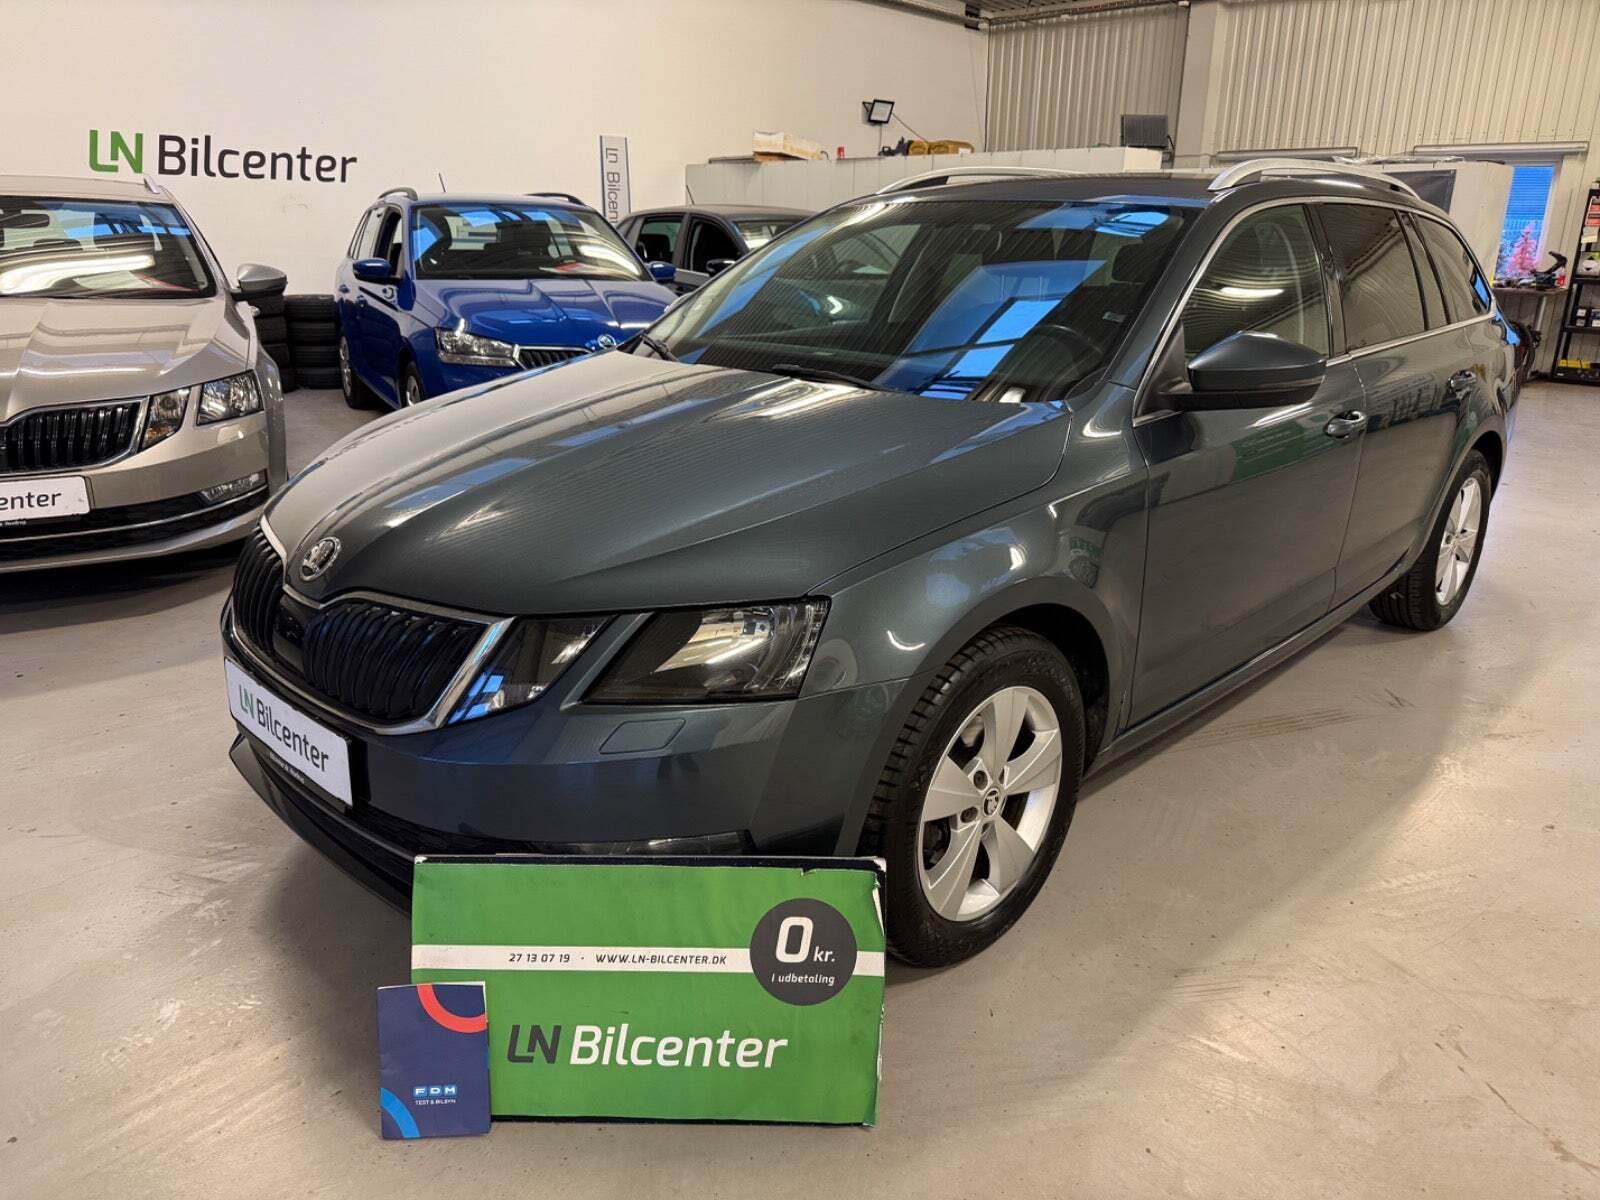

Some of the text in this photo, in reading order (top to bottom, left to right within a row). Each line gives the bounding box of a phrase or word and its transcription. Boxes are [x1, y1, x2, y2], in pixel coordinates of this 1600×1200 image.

[89, 129, 357, 182] LN Bilcenter
[238, 684, 255, 719] LN
[256, 697, 329, 772] Bilcenter
[508, 953, 727, 965] 27 13 07 19 WWW.LN-BILCENTER.DK
[775, 916, 836, 963] 0 kr.
[778, 973, 836, 987] udbetaling
[507, 1023, 789, 1068] LN Bilcenter
